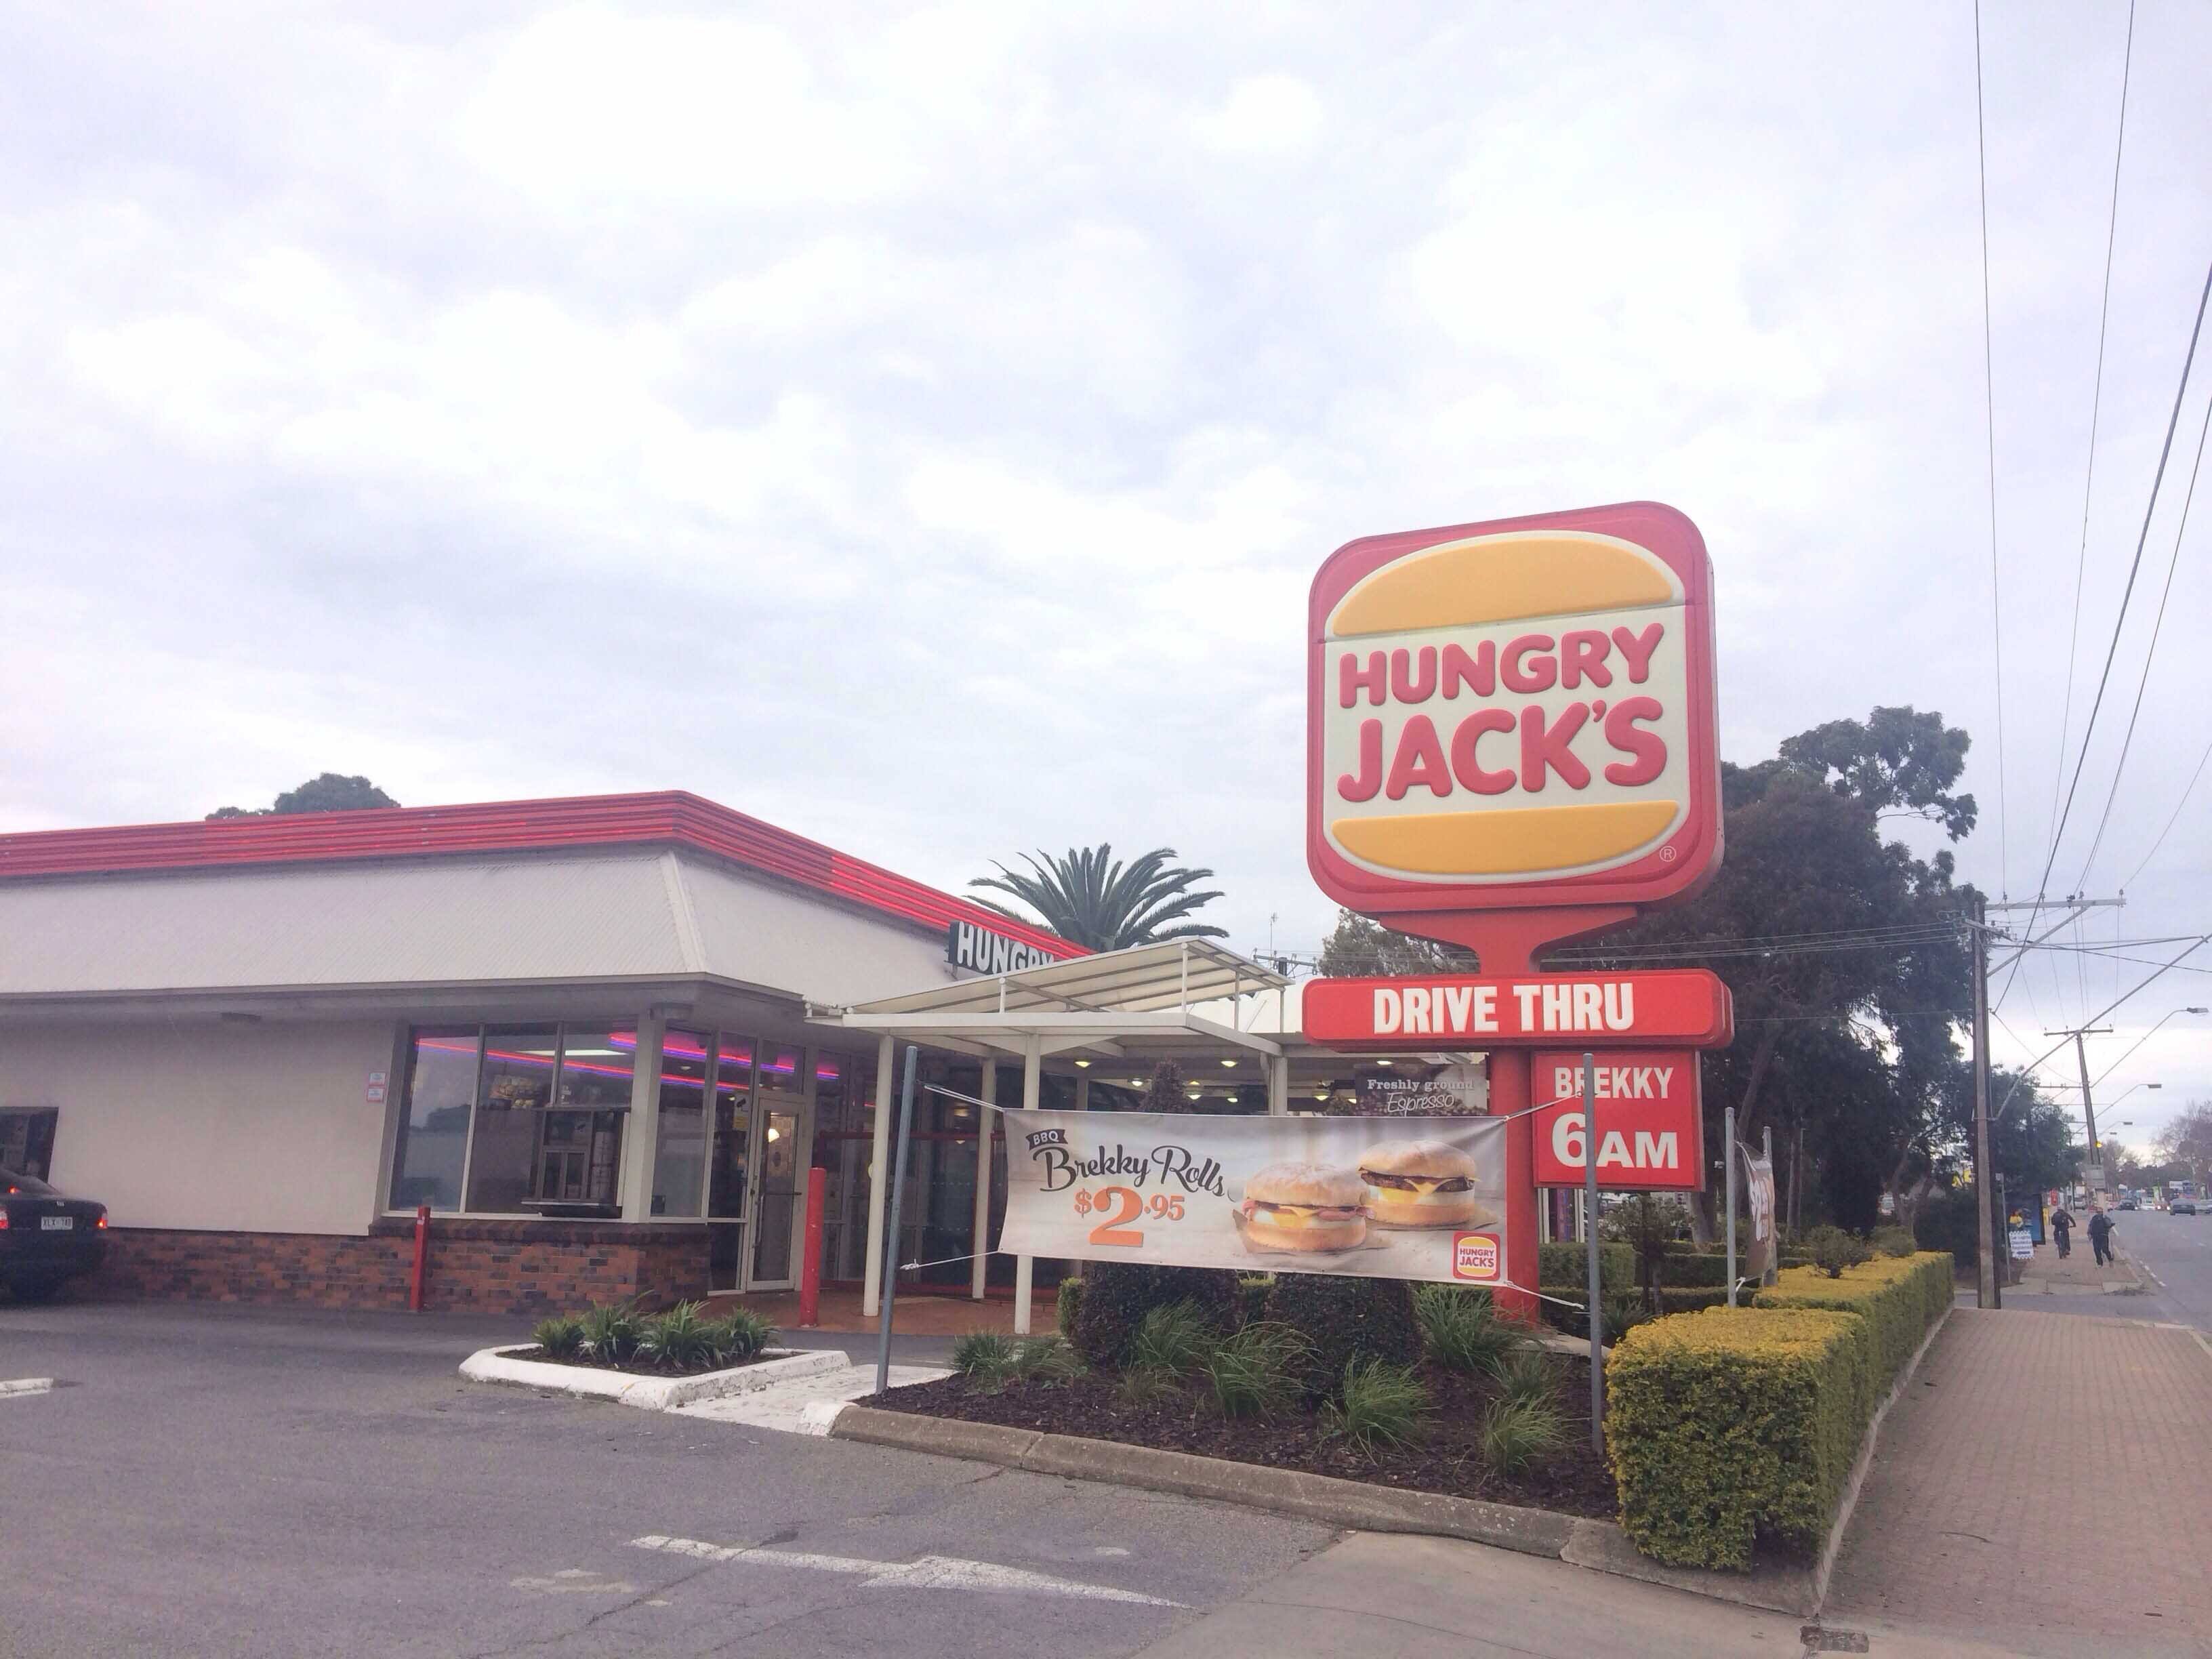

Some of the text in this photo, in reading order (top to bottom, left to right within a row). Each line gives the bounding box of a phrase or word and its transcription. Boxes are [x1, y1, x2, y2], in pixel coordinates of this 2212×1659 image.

[1339, 622, 1664, 709] HUNGRY
[1337, 696, 1667, 803] JACK'S
[1374, 982, 1635, 1035] DRIVE THRU
[1366, 1079, 1473, 1092] Freshly ground
[1387, 1092, 1455, 1116] Espresso
[1032, 1130, 1060, 1146] BBQ
[1032, 1144, 1225, 1197] Brekky Rolls
[1459, 1248, 1495, 1257] HUNGRY
